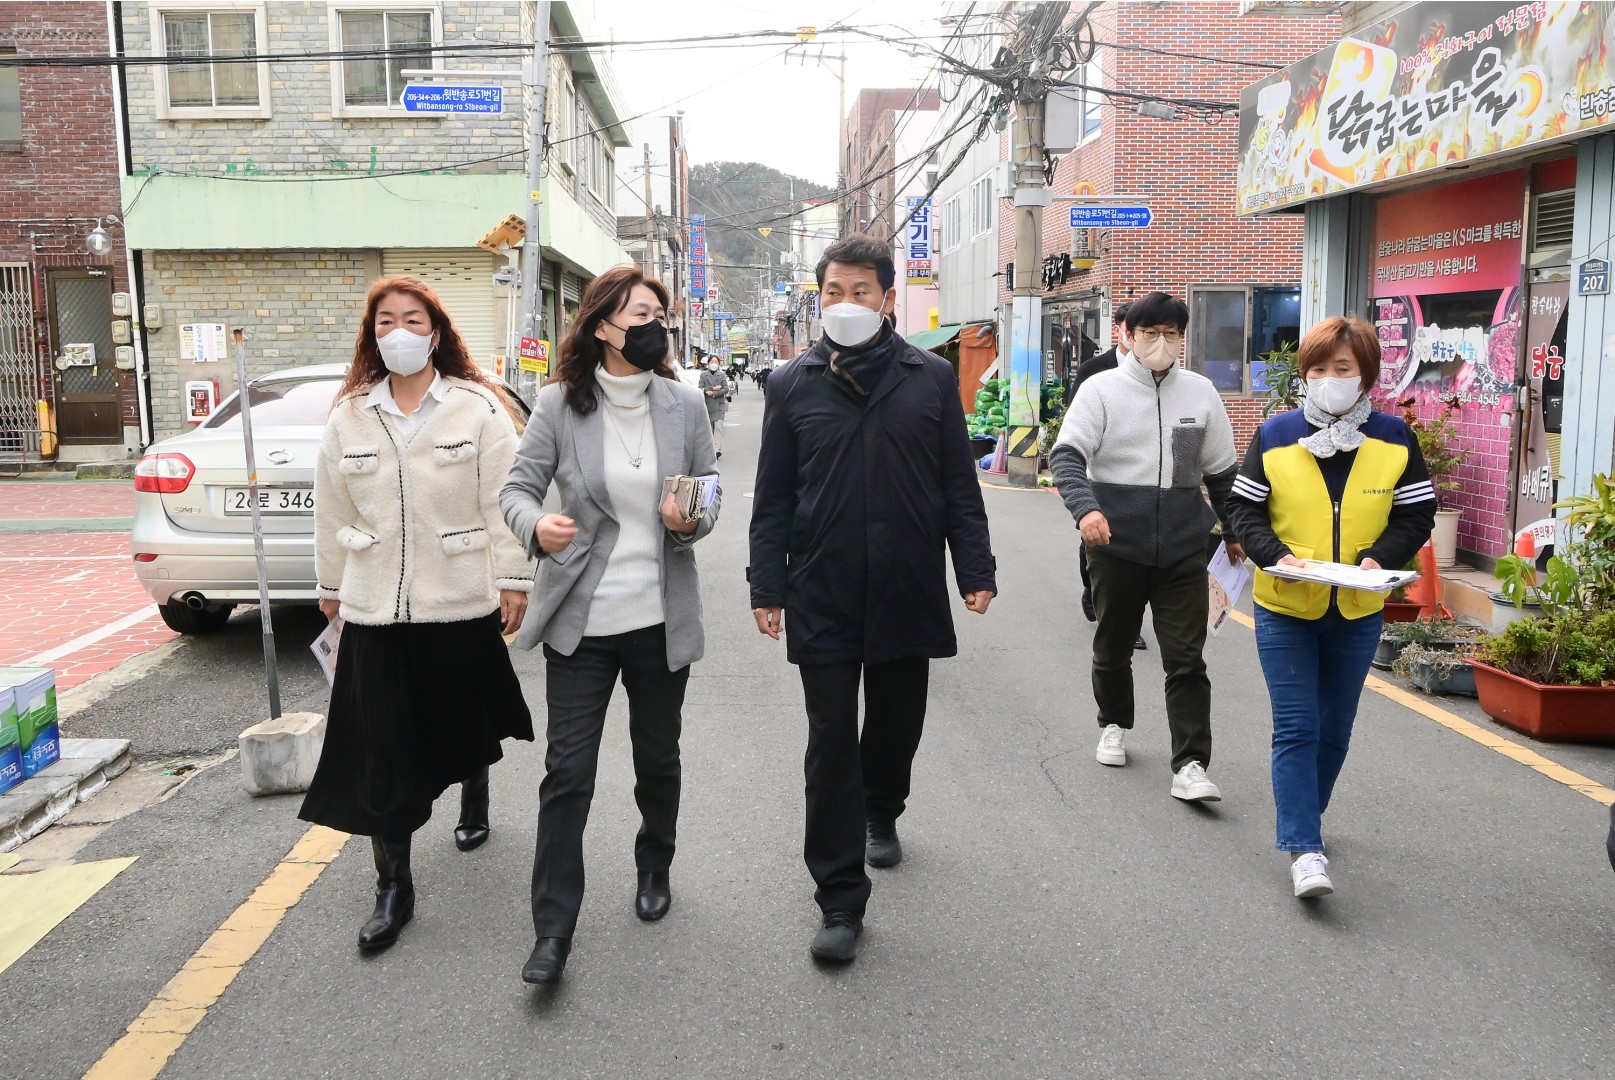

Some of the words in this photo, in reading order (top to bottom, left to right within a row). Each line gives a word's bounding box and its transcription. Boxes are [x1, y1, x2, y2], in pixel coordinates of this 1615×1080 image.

[1400, 49, 1432, 75] 100%
[1435, 24, 1493, 59] 직화구이
[1496, 1, 1548, 36] 전문점
[416, 101, 463, 112] Witbansong-ro
[464, 102, 499, 112] 51beon-gil
[443, 88, 500, 102] 윗반송로51번길
[1071, 209, 1117, 219] 윗반송로51번길
[1111, 219, 1139, 227] 51beon-gil
[909, 206, 930, 259] 참기름
[1378, 239, 1405, 258] 참숯나라
[1406, 230, 1452, 253] 닭굽는마을은
[1493, 219, 1522, 241] 획득한
[1377, 263, 1397, 283] 국내산
[1398, 260, 1435, 281] 닭고기만을
[1435, 255, 1479, 277] 사용합니다.
[1582, 275, 1605, 292] 207
[1532, 295, 1561, 324] 참숯나라
[1532, 342, 1566, 380] 닭굽
[1522, 465, 1550, 503] 바베큐
[279, 491, 314, 509] 346
